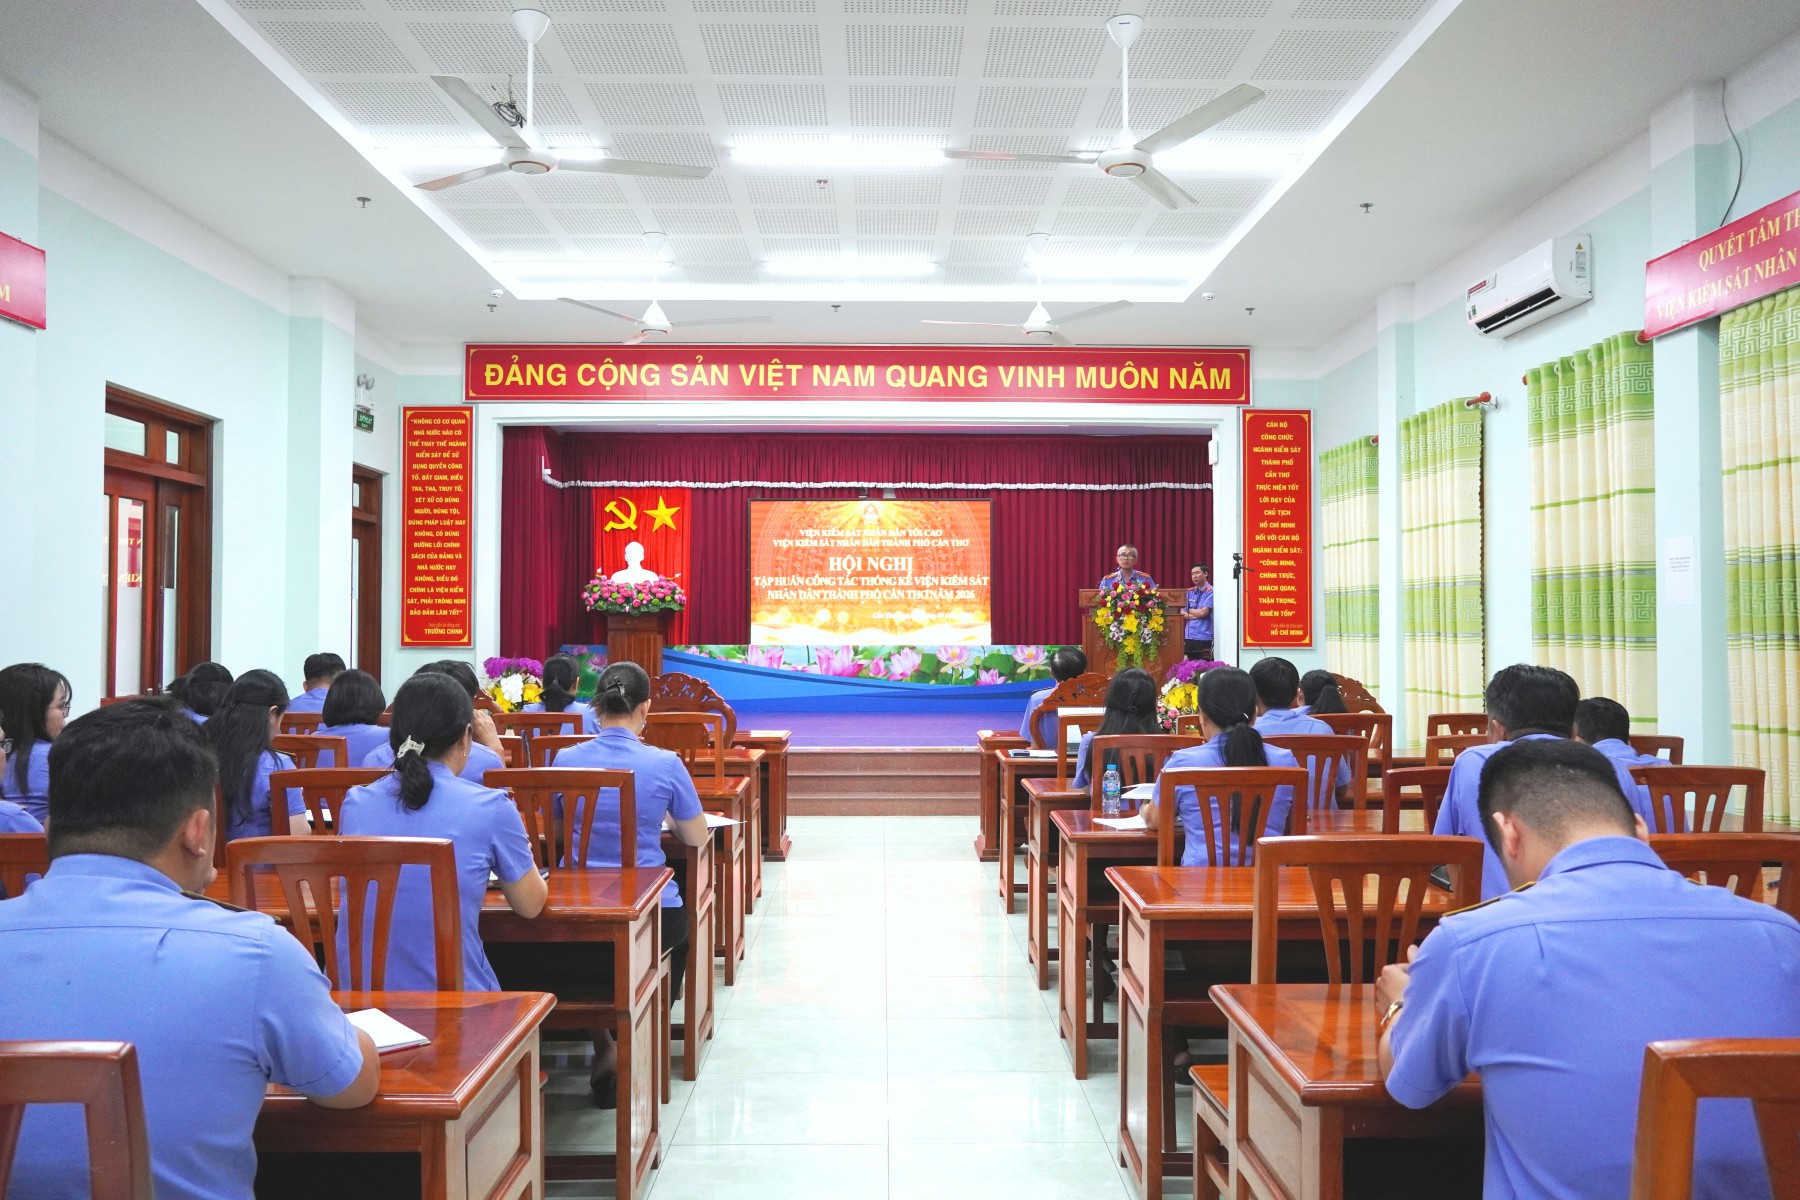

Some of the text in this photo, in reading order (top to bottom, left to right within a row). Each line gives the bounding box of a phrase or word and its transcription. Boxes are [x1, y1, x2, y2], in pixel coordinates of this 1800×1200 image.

[1699, 231, 1745, 272] QUYẾT
[1747, 217, 1781, 248] TÂM
[1725, 266, 1751, 295] SÁT
[1754, 248, 1798, 282] NHÂN
[485, 355, 1231, 391] ĐẢNG CỘNG SẢN VIỆT NAM QUANG VINH MUÔN NĂM
[829, 554, 914, 575] HỘI NGHỊ
